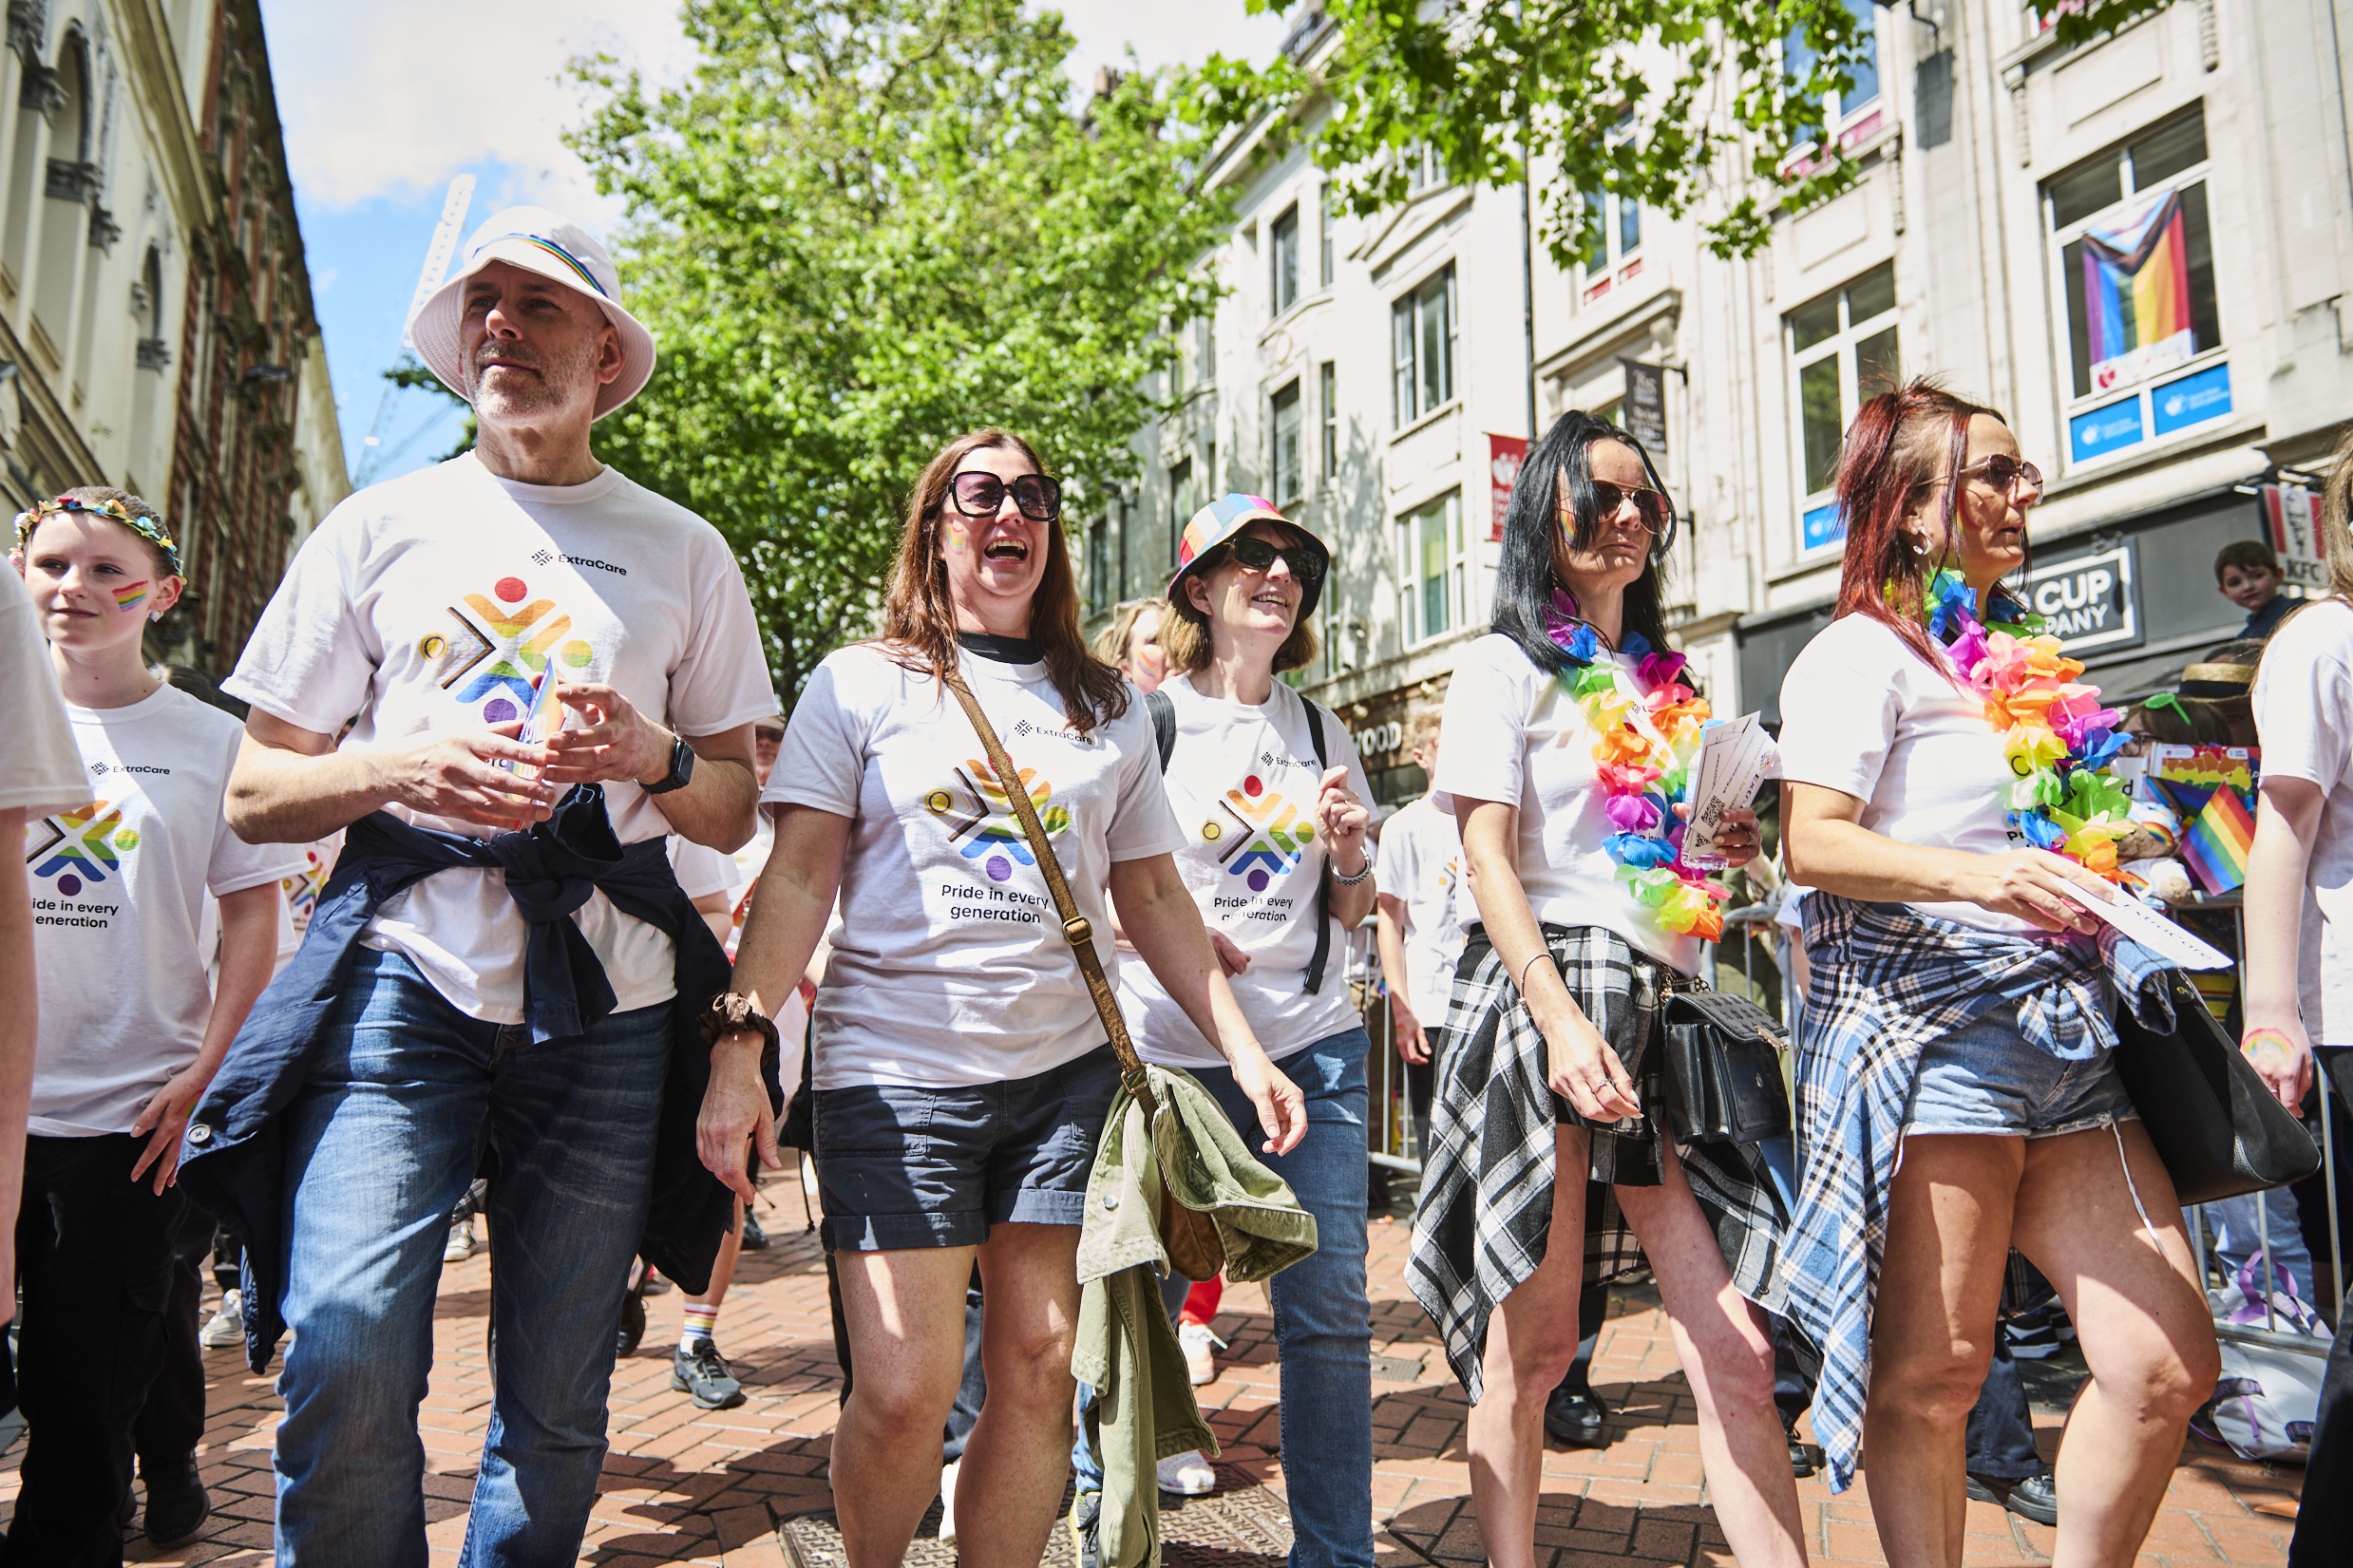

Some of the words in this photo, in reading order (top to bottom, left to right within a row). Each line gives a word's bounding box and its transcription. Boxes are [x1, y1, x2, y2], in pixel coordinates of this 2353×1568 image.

[559, 555, 627, 576] ExtraCare
[2287, 559, 2321, 581] KFC
[2035, 569, 2112, 615] CUP
[2030, 602, 2108, 637] PANY
[1036, 727, 1092, 745] ExtraCare
[113, 765, 171, 775] ExtraCare
[1729, 793, 1740, 809] olde
[32, 897, 57, 911] ide
[60, 899, 74, 912] in
[77, 903, 120, 916] every
[941, 884, 984, 899] Pride
[989, 886, 1004, 901] in
[1008, 892, 1049, 910] every
[1214, 897, 1248, 908] Pride
[1251, 896, 1263, 905] in
[1266, 897, 1294, 909] every
[34, 915, 108, 929] eneration
[950, 905, 1041, 924] generation
